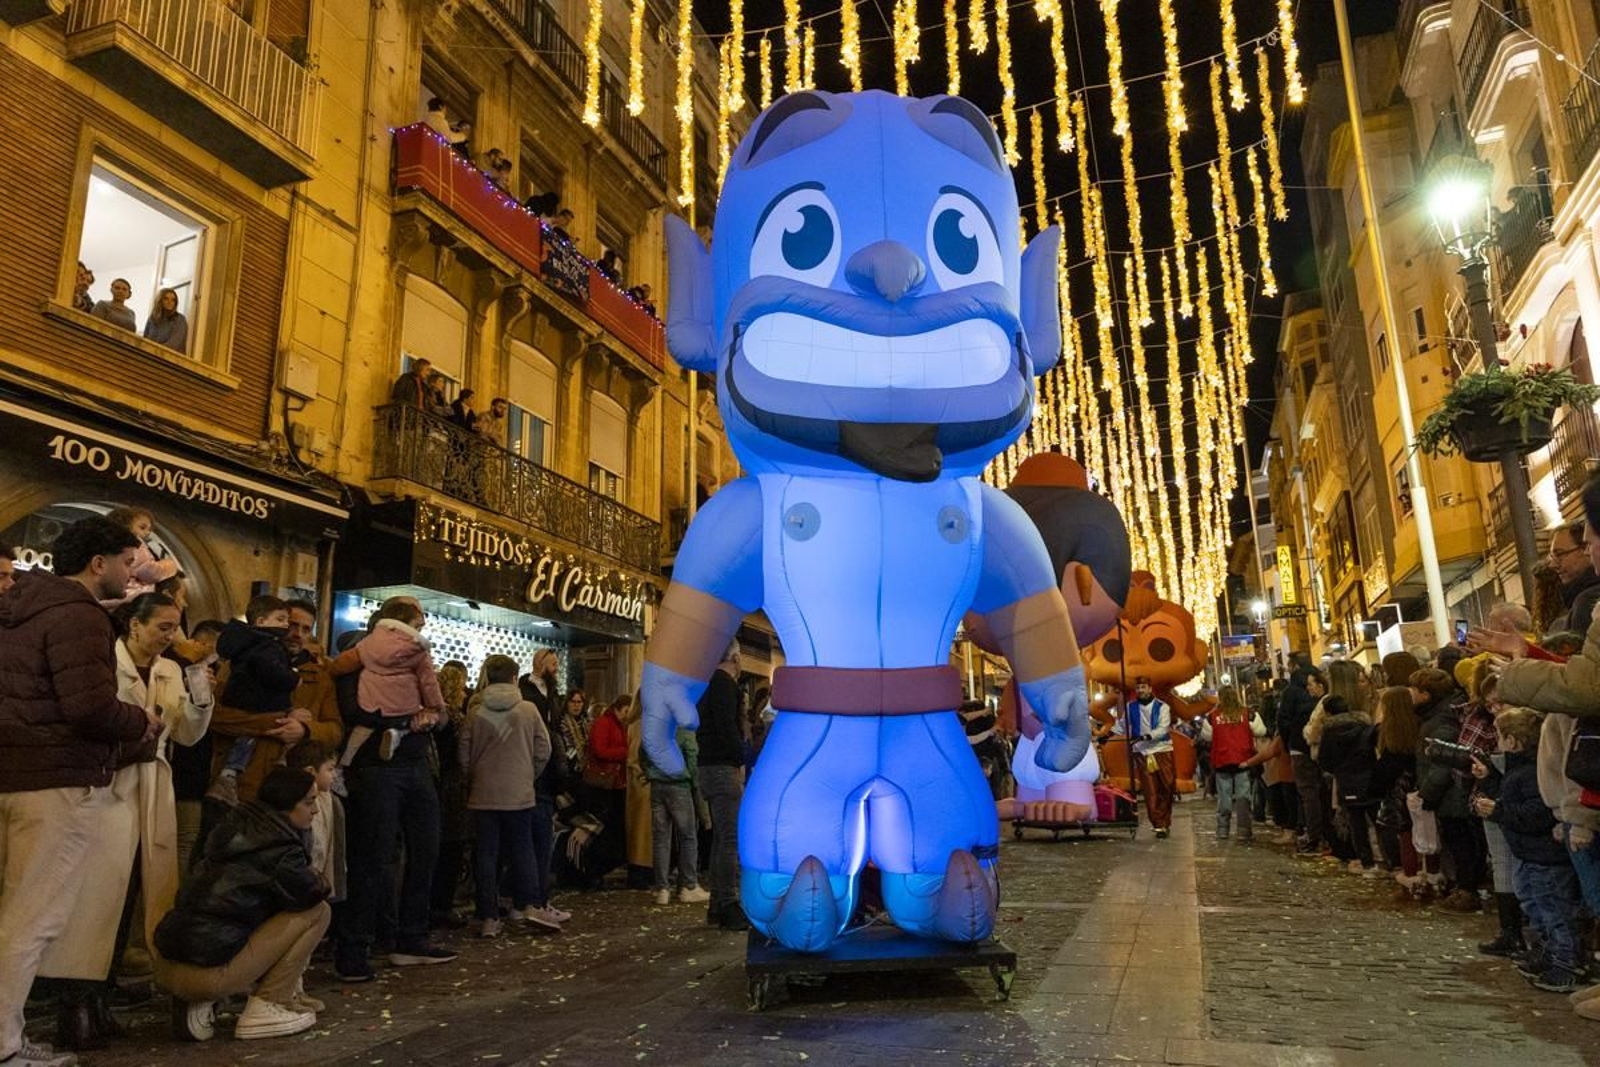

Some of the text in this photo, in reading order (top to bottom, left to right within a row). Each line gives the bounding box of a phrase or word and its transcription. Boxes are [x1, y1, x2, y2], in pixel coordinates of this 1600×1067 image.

[48, 434, 270, 520] 100 MONTADITOS
[438, 517, 525, 566] TEJIDOS
[528, 556, 643, 622] El Carmen
[1279, 547, 1294, 602] AMATE
